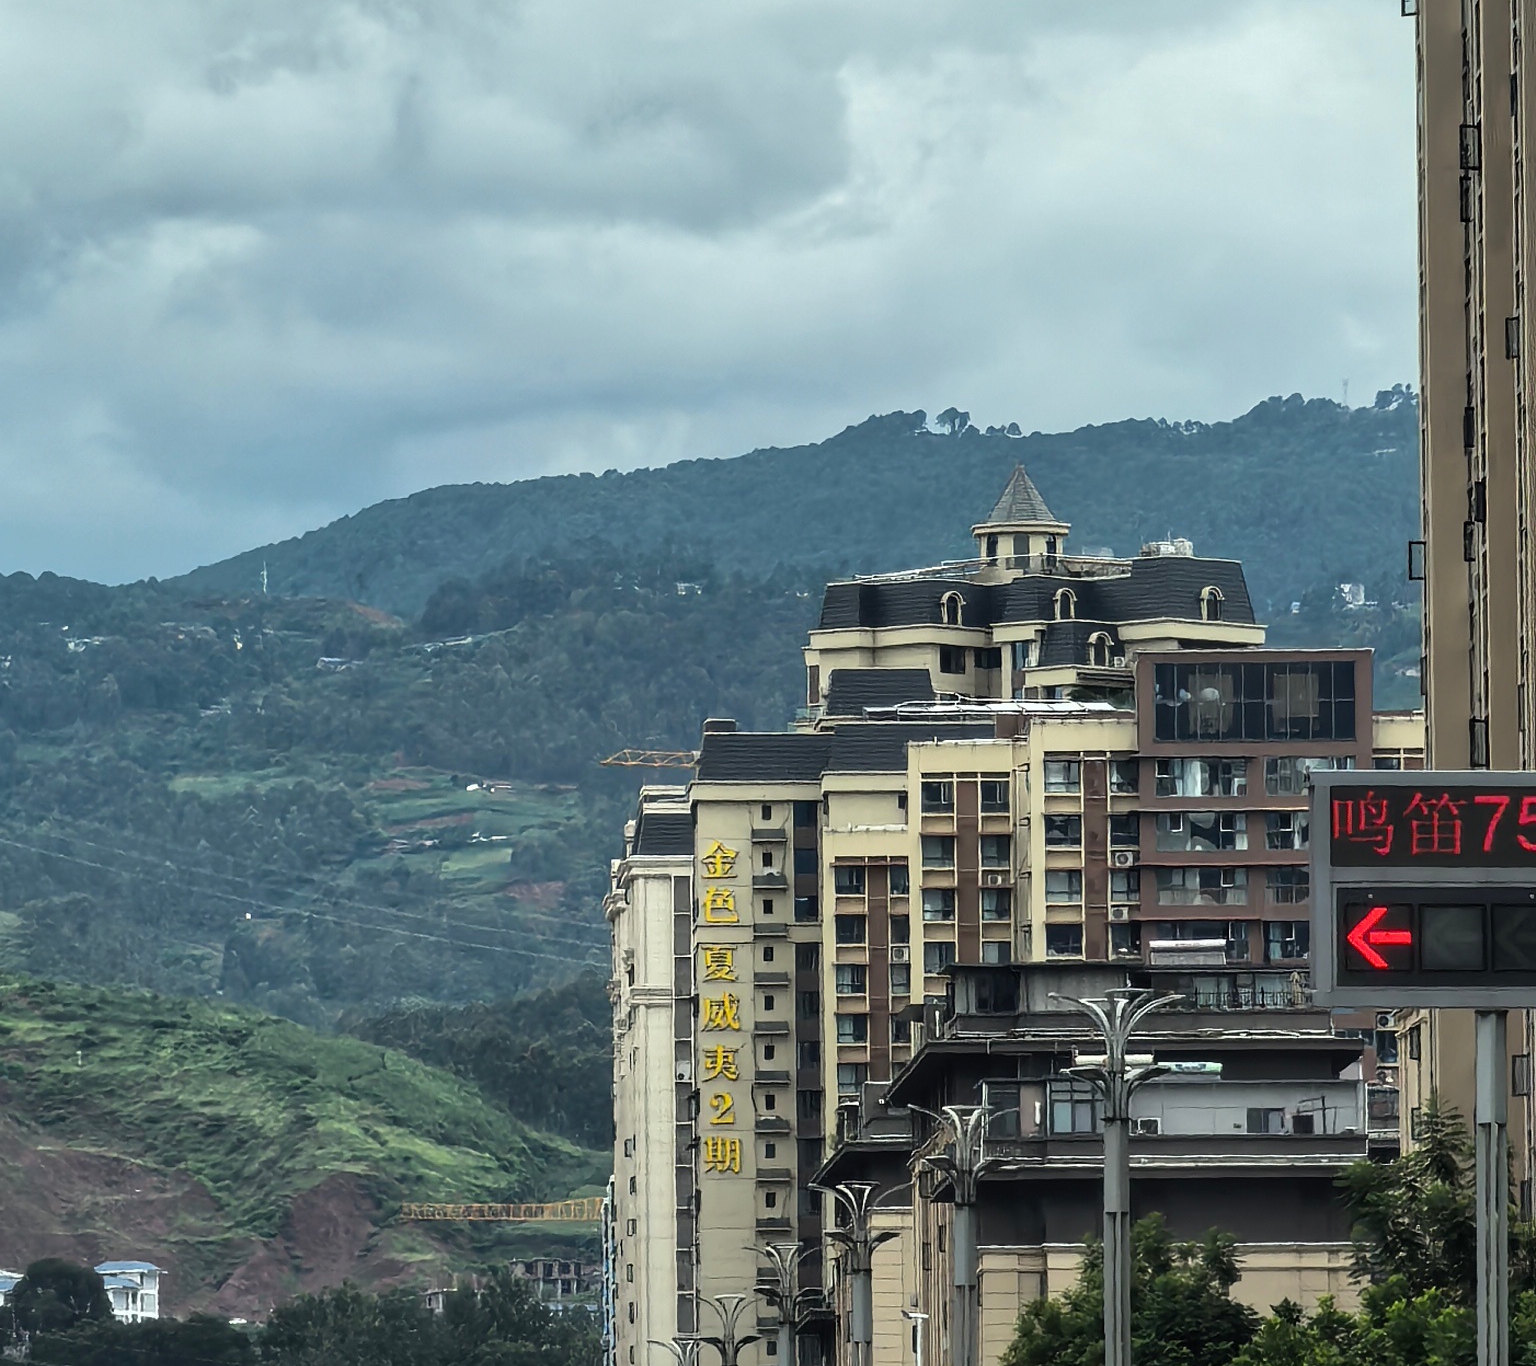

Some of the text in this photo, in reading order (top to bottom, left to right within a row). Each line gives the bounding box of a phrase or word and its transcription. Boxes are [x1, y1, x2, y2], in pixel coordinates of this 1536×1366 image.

[701, 839, 742, 1175] 金色夏威夷2期
